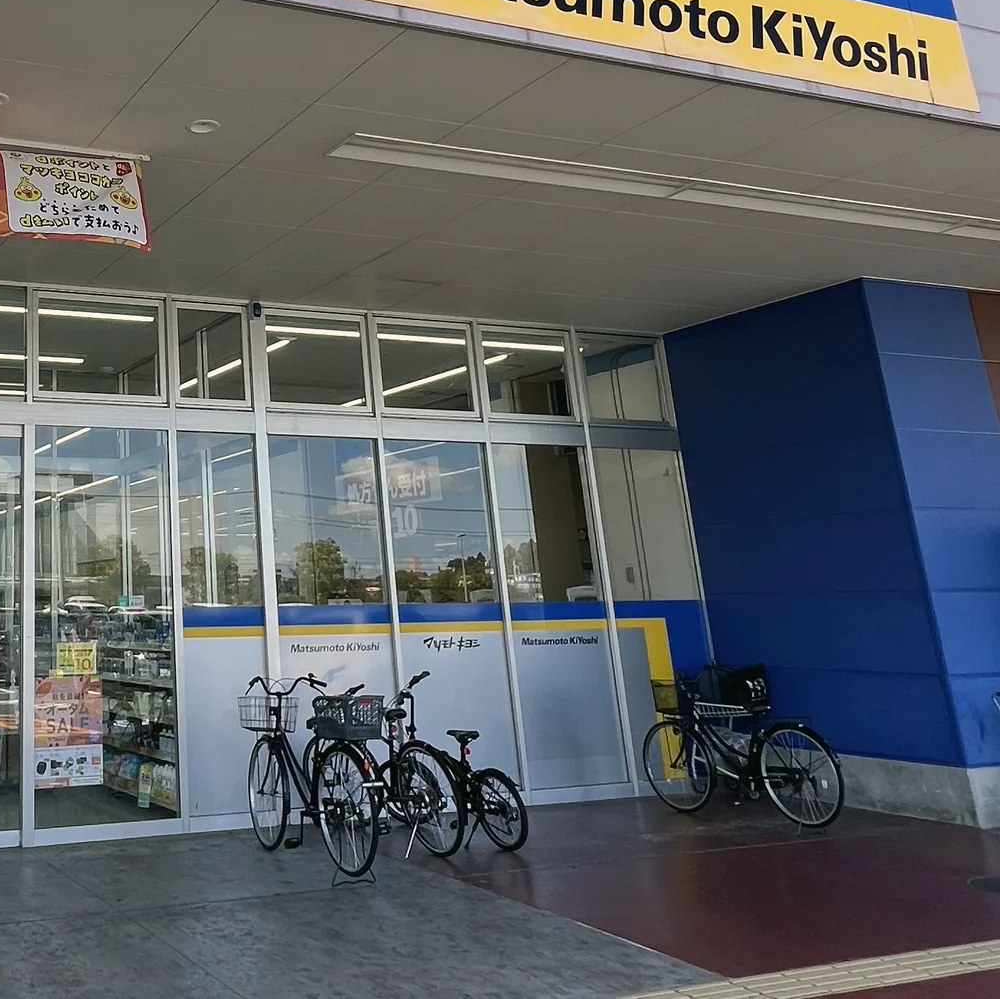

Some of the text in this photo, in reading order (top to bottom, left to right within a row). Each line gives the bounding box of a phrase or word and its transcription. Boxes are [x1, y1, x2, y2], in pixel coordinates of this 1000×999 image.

[750, 4, 930, 81] KiYoshi
[54, 181, 100, 202] ポイント
[347, 469, 427, 506] 処方ん受付
[290, 641, 380, 654] Matsumoto KiYoshi
[423, 636, 481, 652] マツモトキヨシ
[521, 635, 599, 646] Matsumoto KiYoshi
